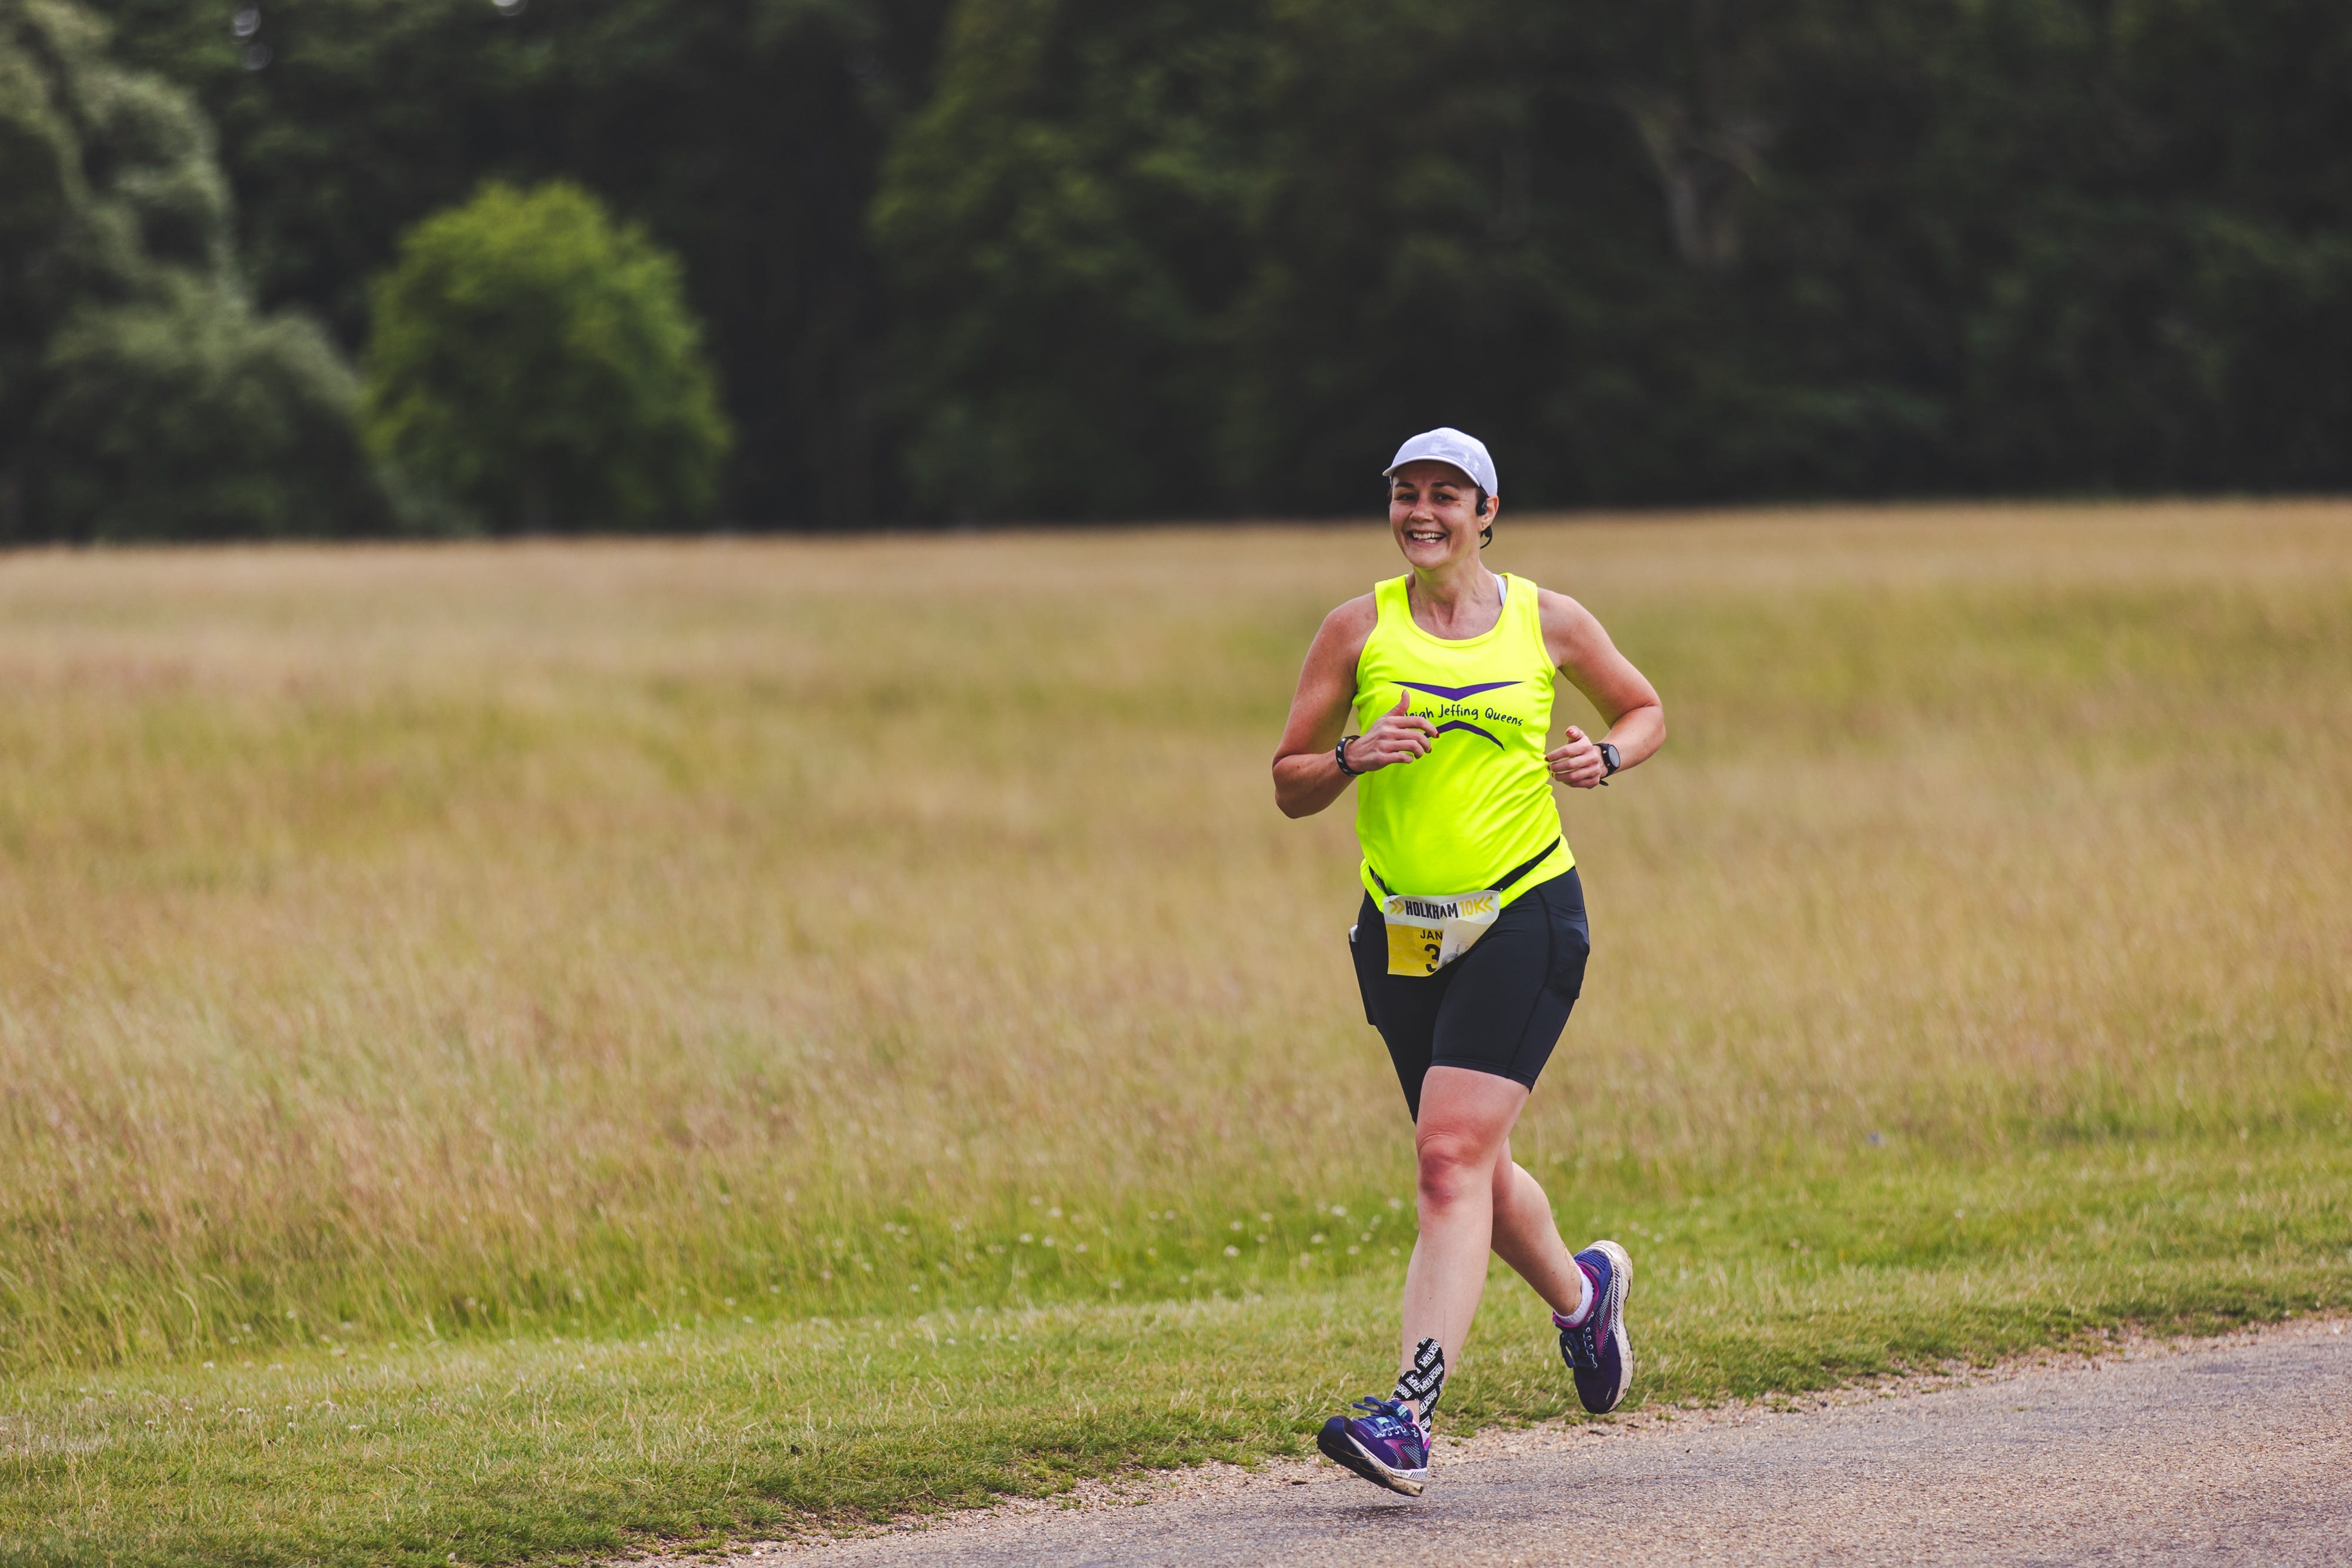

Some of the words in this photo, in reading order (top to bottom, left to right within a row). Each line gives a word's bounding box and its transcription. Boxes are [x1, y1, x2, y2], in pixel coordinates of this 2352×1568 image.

[1438, 704, 1478, 720] Jeffing
[1485, 707, 1523, 727] Queens
[1405, 900, 1459, 920] HOLKHAM
[1419, 1364, 1444, 1391] ROCKTAPE
